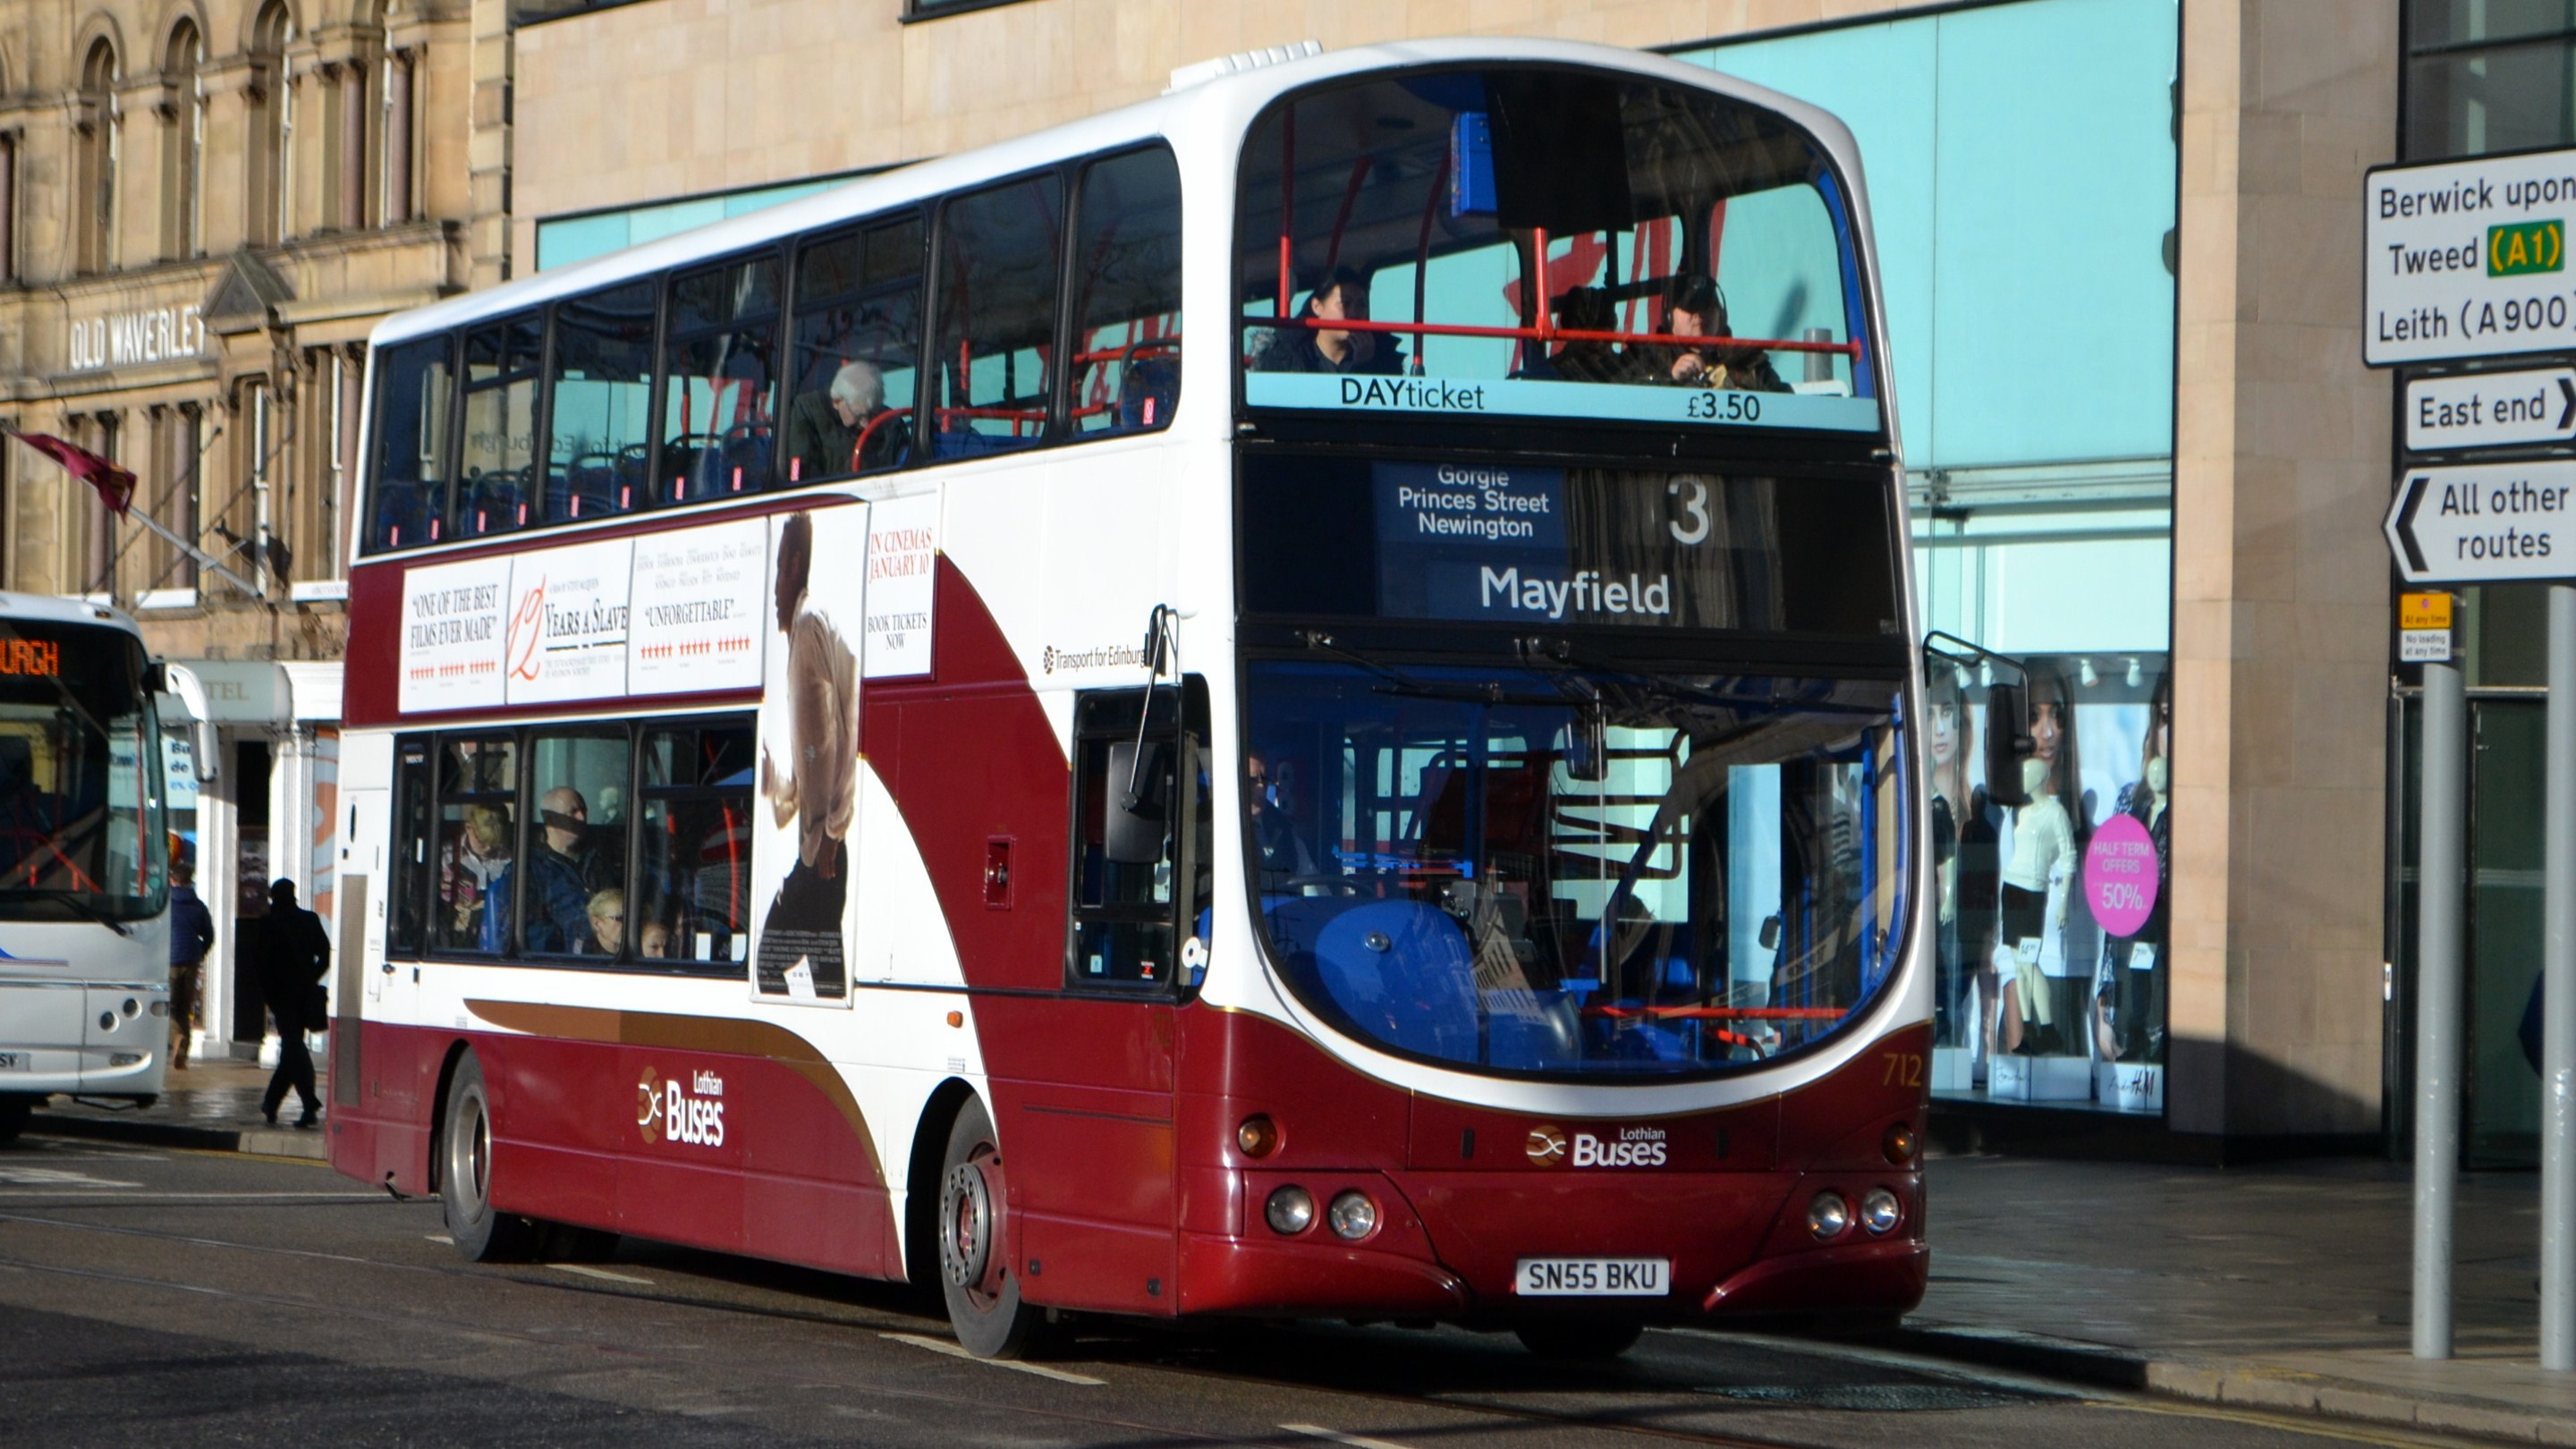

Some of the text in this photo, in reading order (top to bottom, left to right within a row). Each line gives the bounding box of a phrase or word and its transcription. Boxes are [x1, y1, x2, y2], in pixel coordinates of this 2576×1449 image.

[2379, 174, 2576, 219] Berwick upon
[2389, 224, 2561, 275] Tweed (A1)
[71, 304, 205, 370] OLD WAVERLEY
[2379, 307, 2447, 343] Leith
[1341, 377, 1761, 422] DAYticket £3.50
[2419, 387, 2546, 428] East end
[1437, 463, 1510, 490] Gorgie
[1399, 486, 1550, 513] Princes Street
[1668, 476, 1710, 546] 3
[2440, 480, 2570, 516] All other
[869, 527, 933, 556] IN CINEMAS
[1419, 512, 1533, 539] Newington
[2458, 526, 2552, 560] routes
[869, 552, 930, 584] JANUARY 10
[437, 589, 452, 615] OF
[453, 586, 472, 614] THE
[473, 583, 499, 612] BEST
[1480, 565, 1671, 619] Mayfield
[410, 621, 437, 649] FILMS
[438, 618, 462, 646] EVER
[546, 603, 580, 639] YEARS
[591, 597, 628, 633] SLAVE
[868, 612, 928, 633] BOOK TICKETS
[886, 632, 906, 651] NOW
[1055, 644, 1146, 673] Transport for Edinburg
[2094, 842, 2149, 857] HALF TERM
[2103, 858, 2140, 874] OFFERS
[2102, 882, 2144, 911] 50%
[693, 1069, 723, 1096] Lothian
[1883, 1053, 1922, 1088] 712
[666, 1080, 724, 1148] Buses
[1573, 1133, 1667, 1166] Buses
[1620, 1127, 1665, 1140] Lothian
[1529, 1263, 1657, 1290] SN55 BKU
